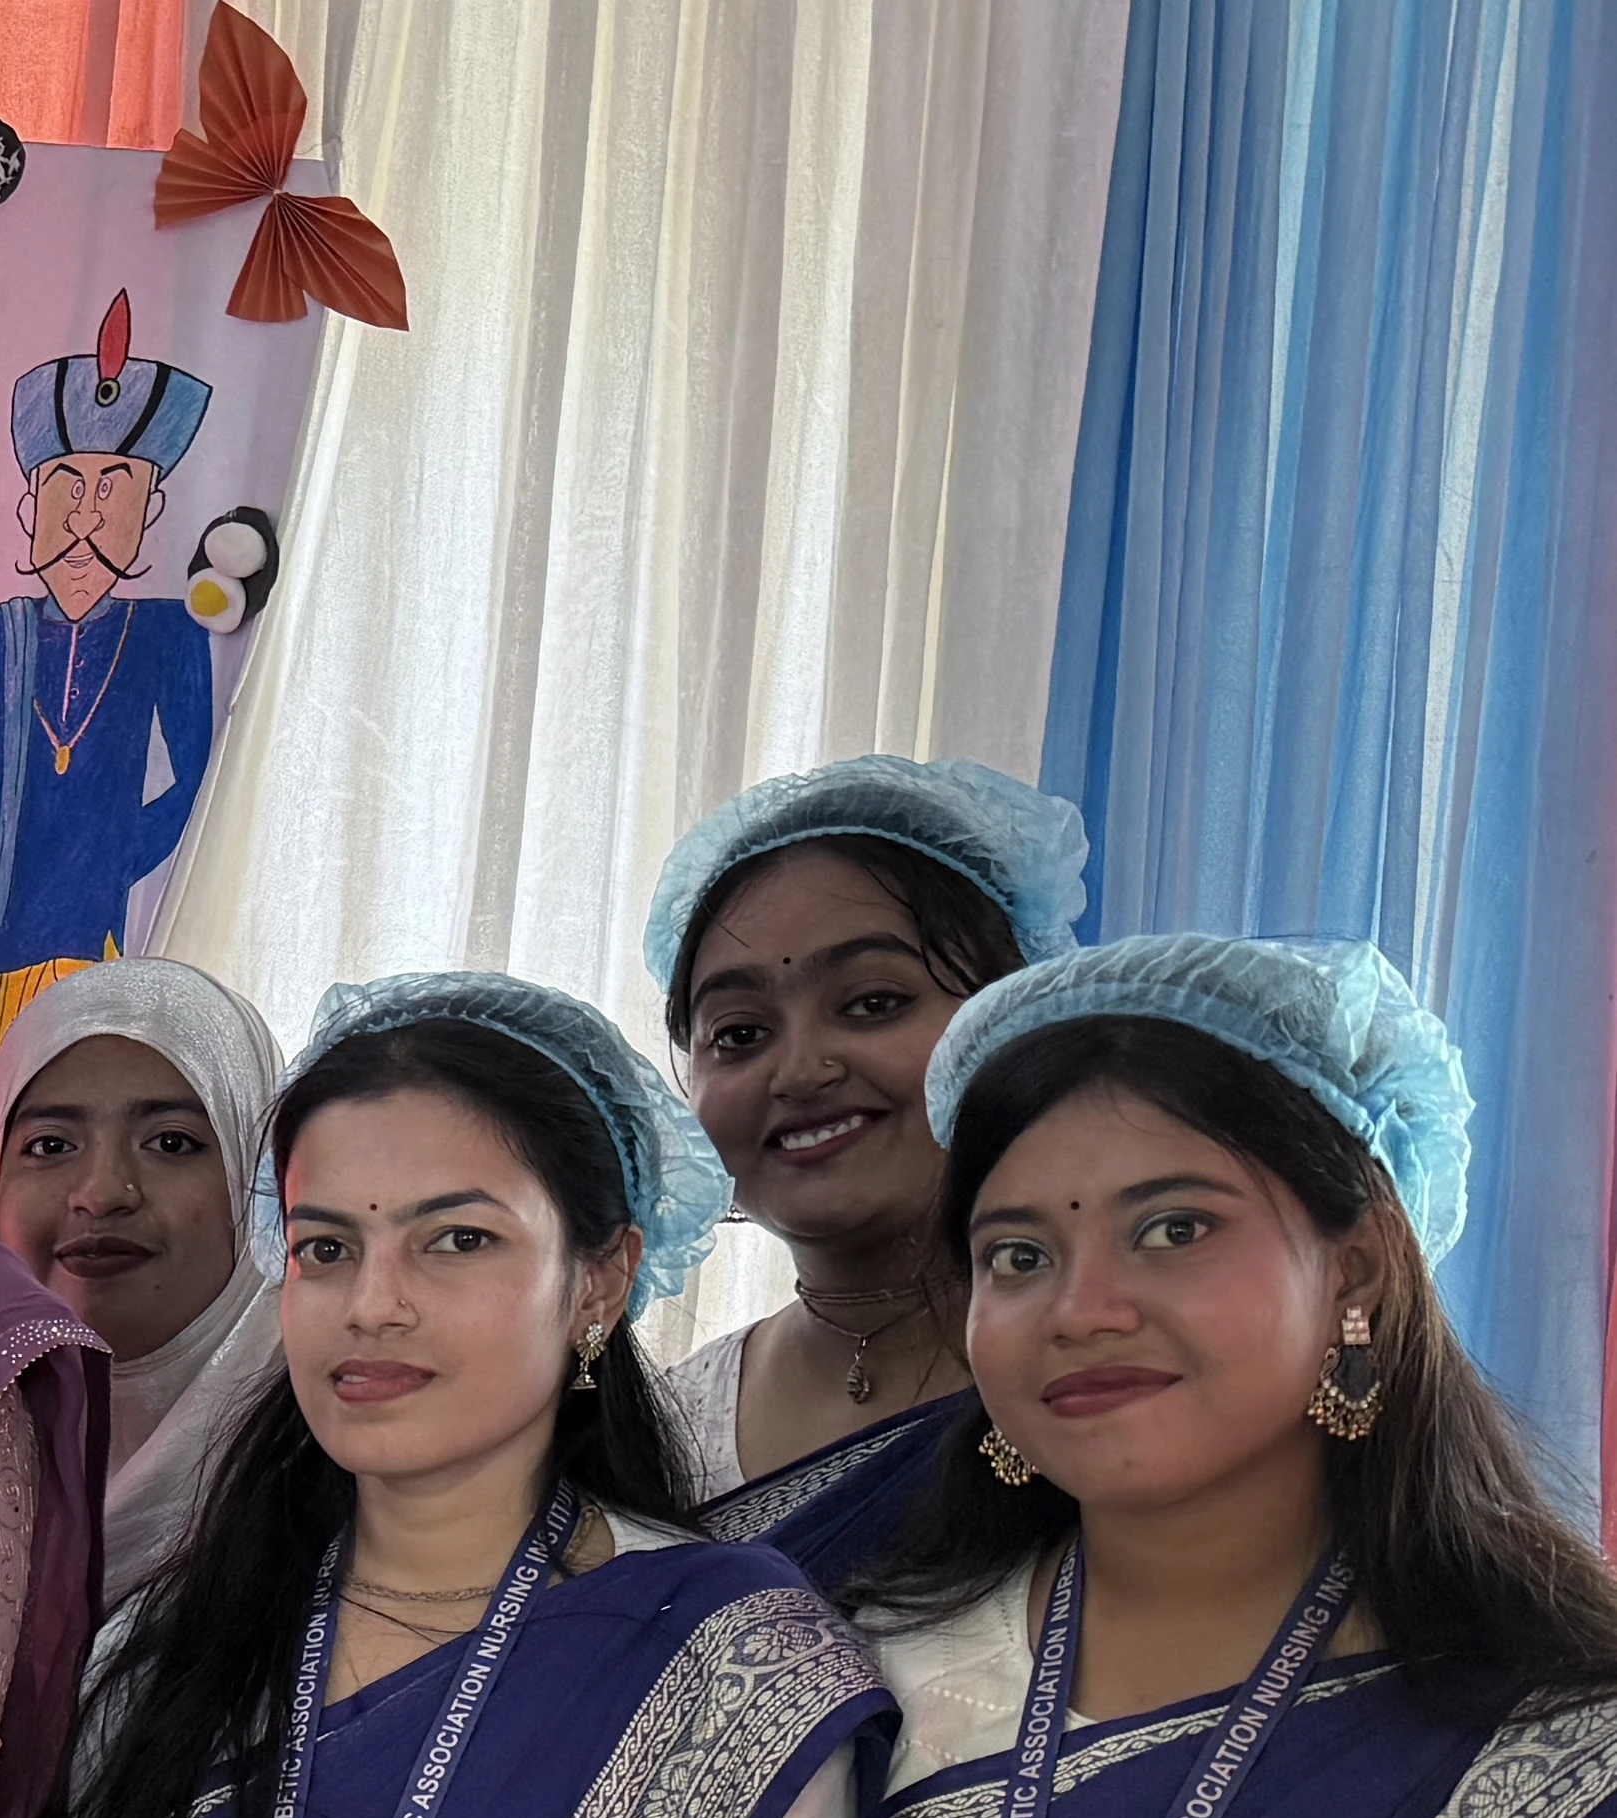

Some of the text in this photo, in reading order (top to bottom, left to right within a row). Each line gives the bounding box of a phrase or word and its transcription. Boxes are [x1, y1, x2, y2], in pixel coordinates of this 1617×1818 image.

[285, 1612, 328, 1752] ASSOCIATION
[412, 1662, 491, 1810] ASSOCIATION
[477, 1565, 539, 1660] NURSING
[1019, 1626, 1067, 1779] ASSOCIATION
[1252, 1605, 1330, 1706] NURSING
